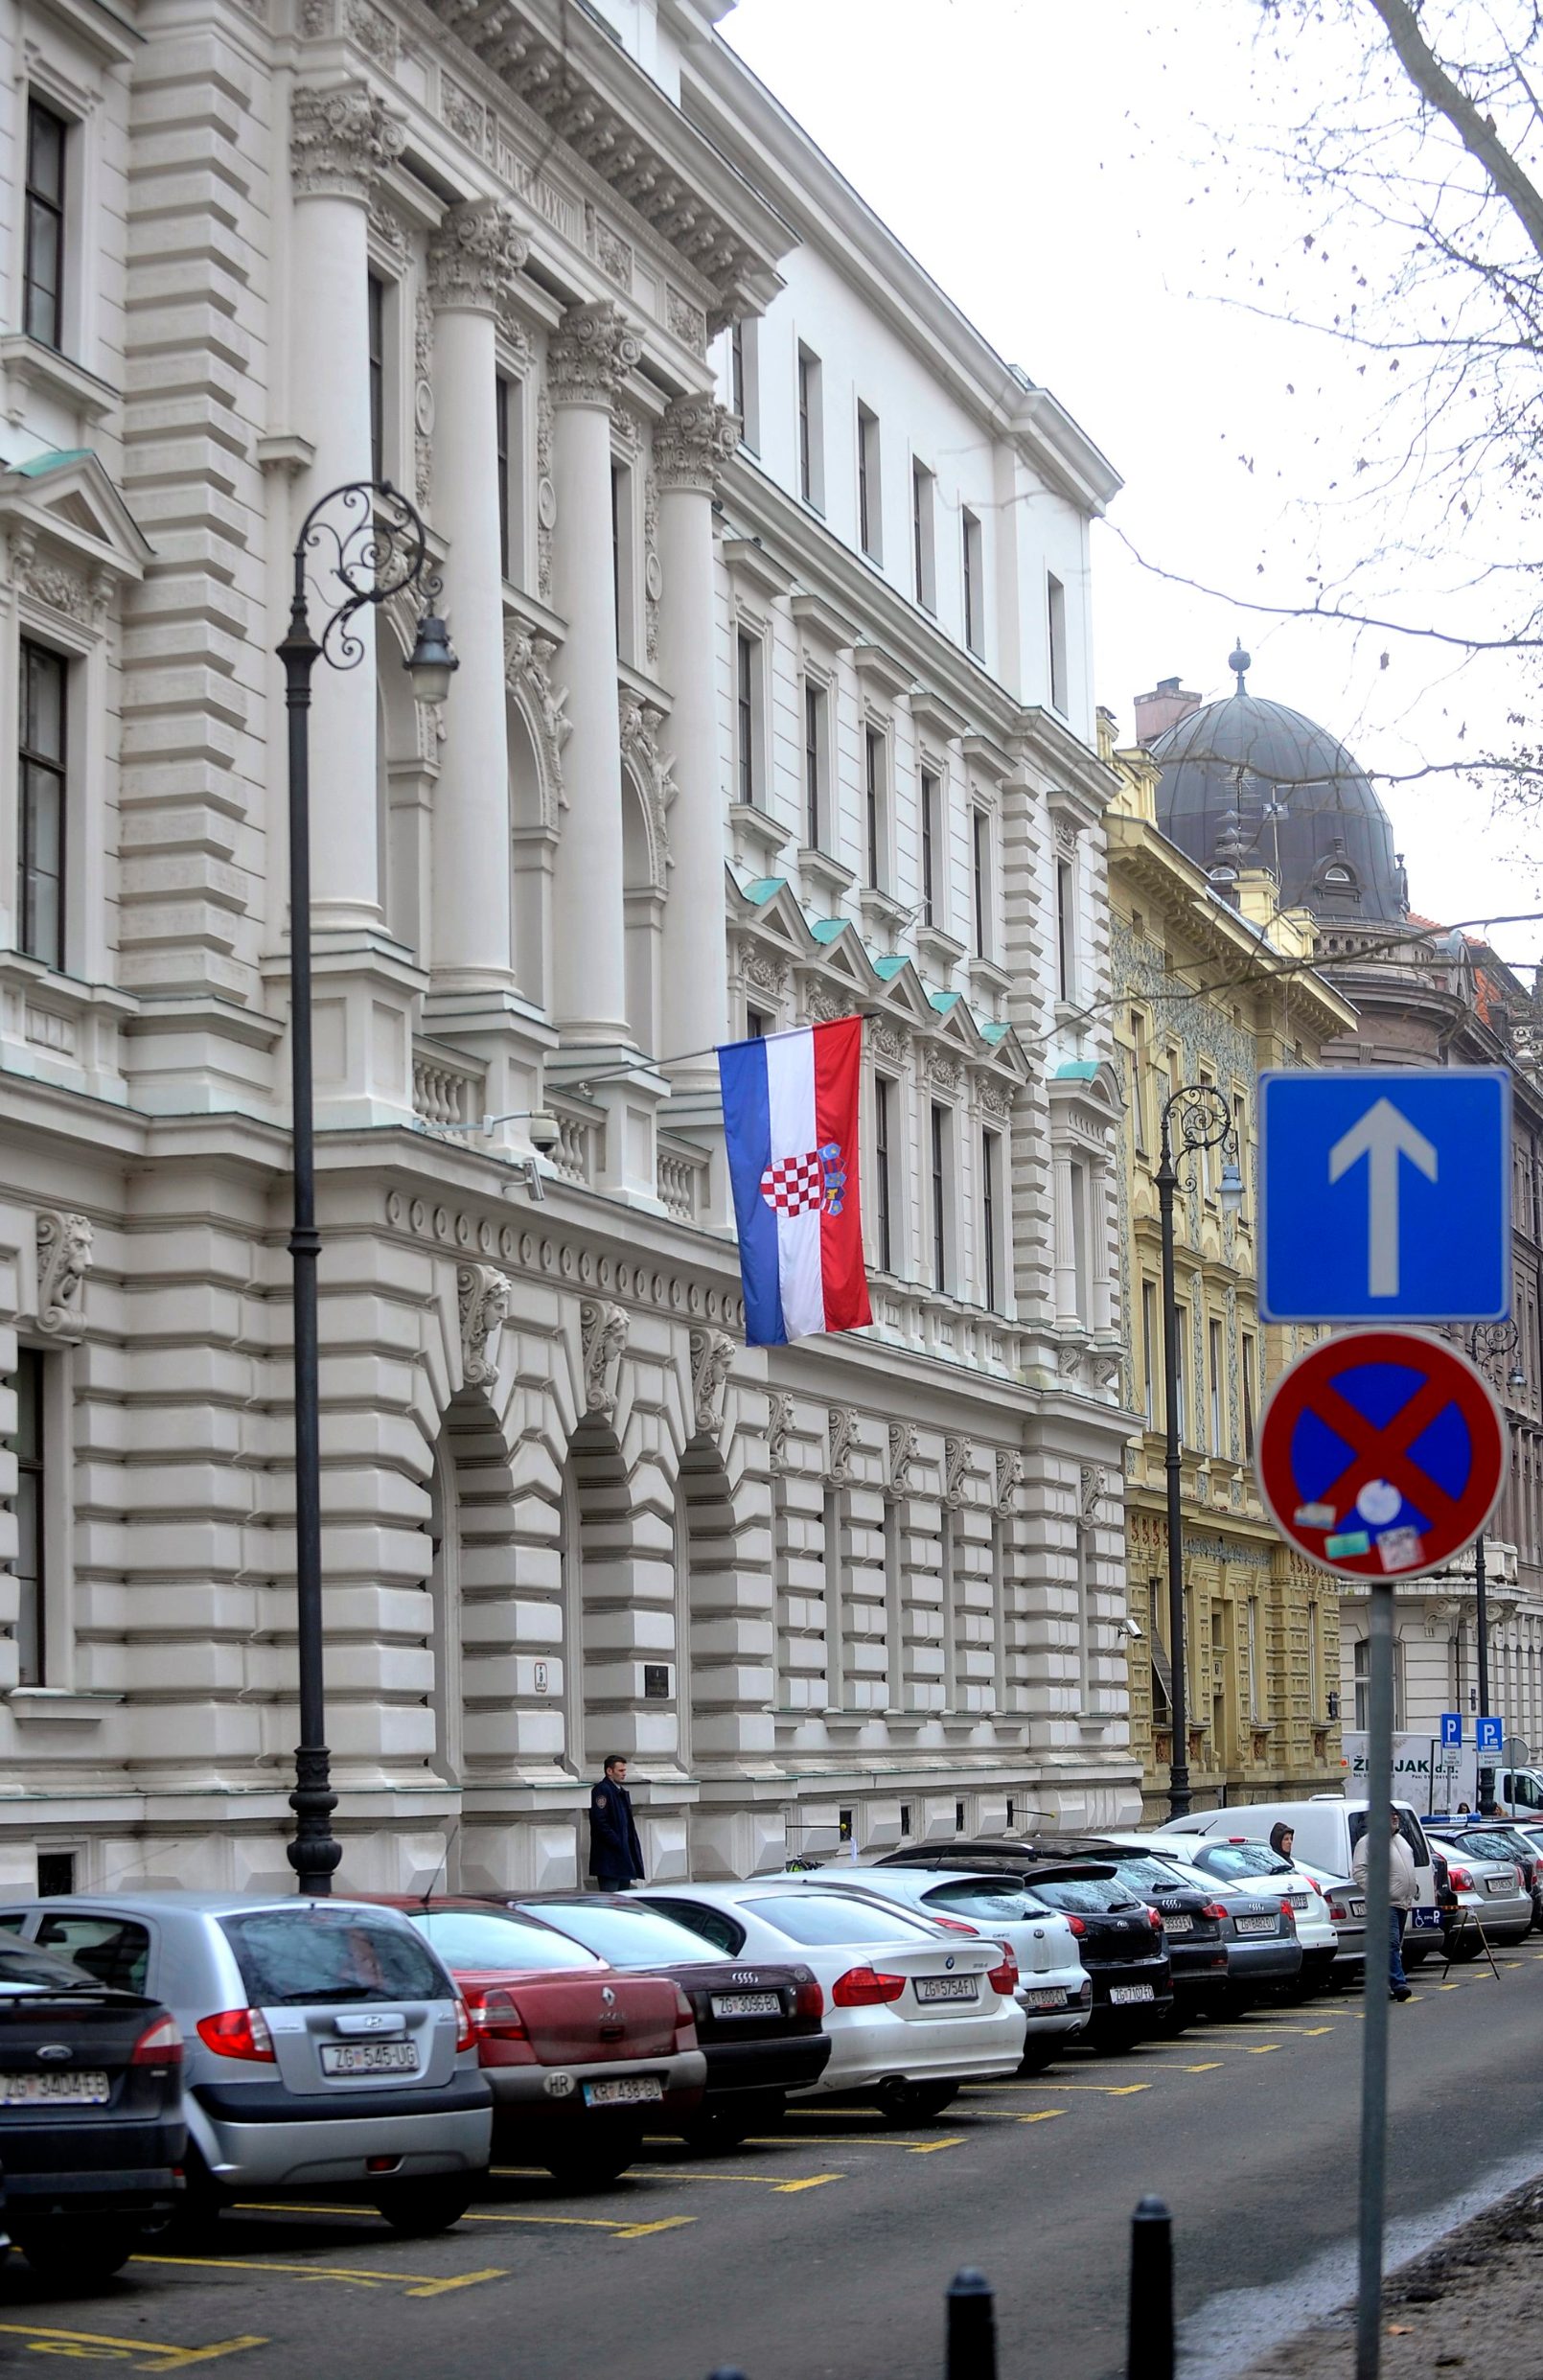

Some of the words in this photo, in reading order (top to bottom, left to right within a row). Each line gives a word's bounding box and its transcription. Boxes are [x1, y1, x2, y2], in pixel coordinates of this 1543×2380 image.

[1446, 1719, 1457, 1742] P
[1484, 1723, 1496, 1745] P
[923, 1981, 936, 1997] ZG
[1115, 1989, 1125, 2000] ZG
[719, 1997, 733, 2013] ZG
[334, 2047, 355, 2068] ZG
[363, 2045, 416, 2067] 545-UG
[4, 2073, 27, 2097] ZG
[549, 2074, 569, 2094] HR
[593, 2083, 610, 2101] KR
